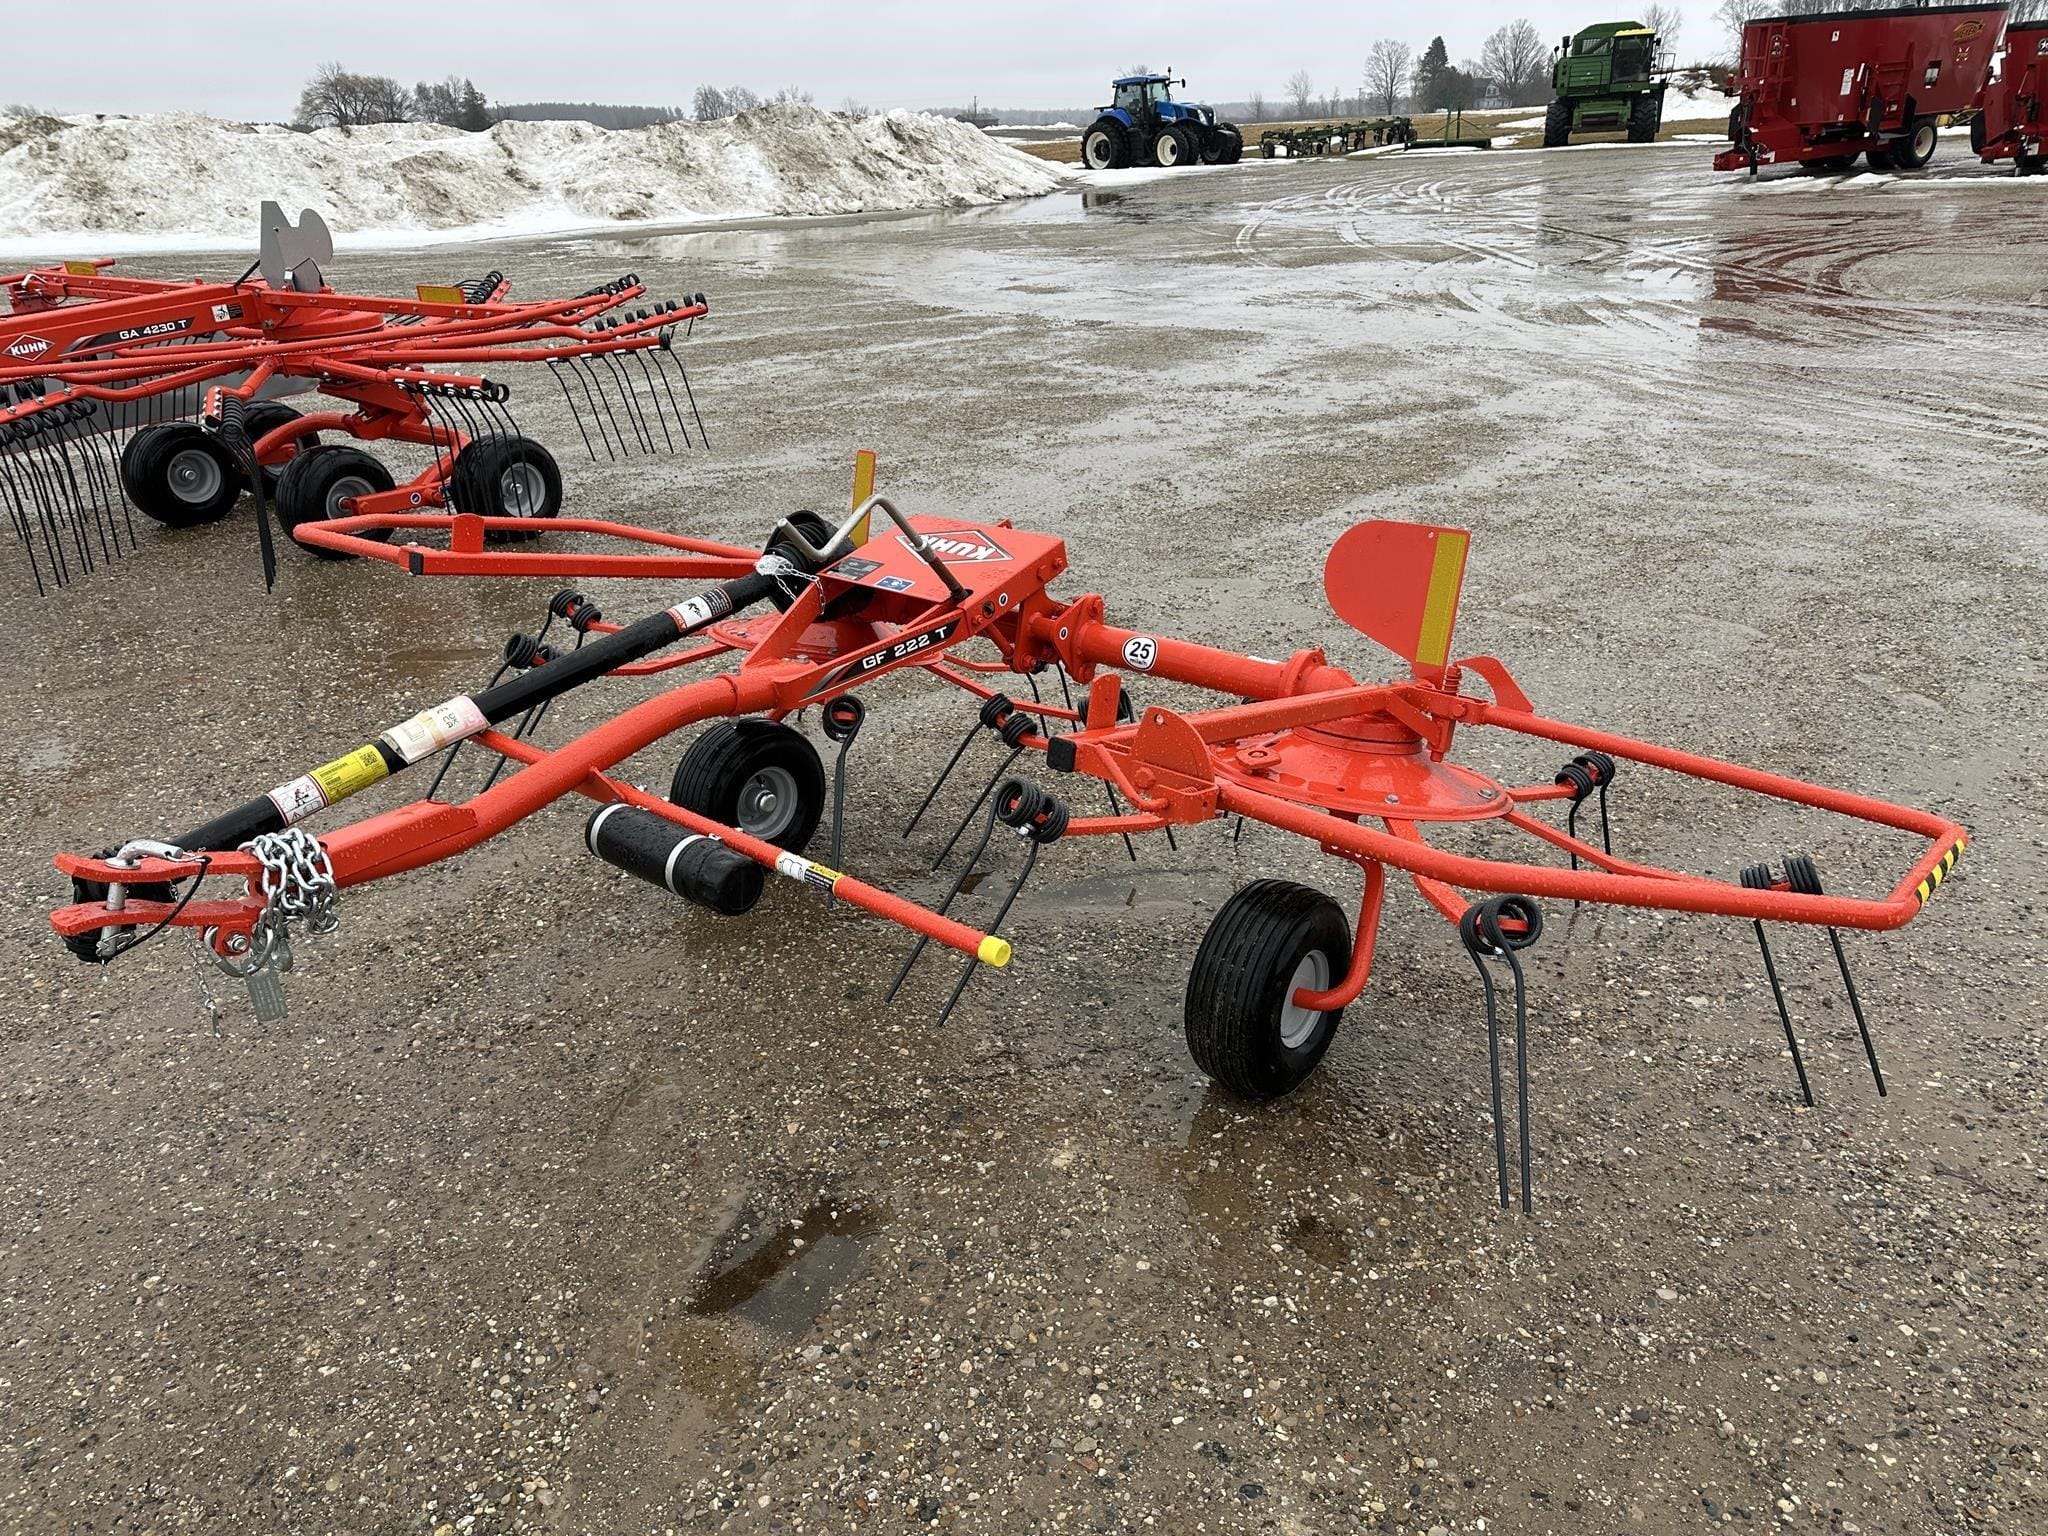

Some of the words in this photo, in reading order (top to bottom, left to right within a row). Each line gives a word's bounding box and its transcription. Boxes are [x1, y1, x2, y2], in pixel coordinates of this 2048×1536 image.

[119, 329, 139, 340] GA
[143, 322, 175, 336] 4230
[177, 319, 187, 330] T
[10, 341, 48, 356] KUHN
[862, 650, 887, 669] GF
[894, 634, 930, 657] 222
[934, 626, 947, 639] T
[1129, 641, 1152, 659] 25
